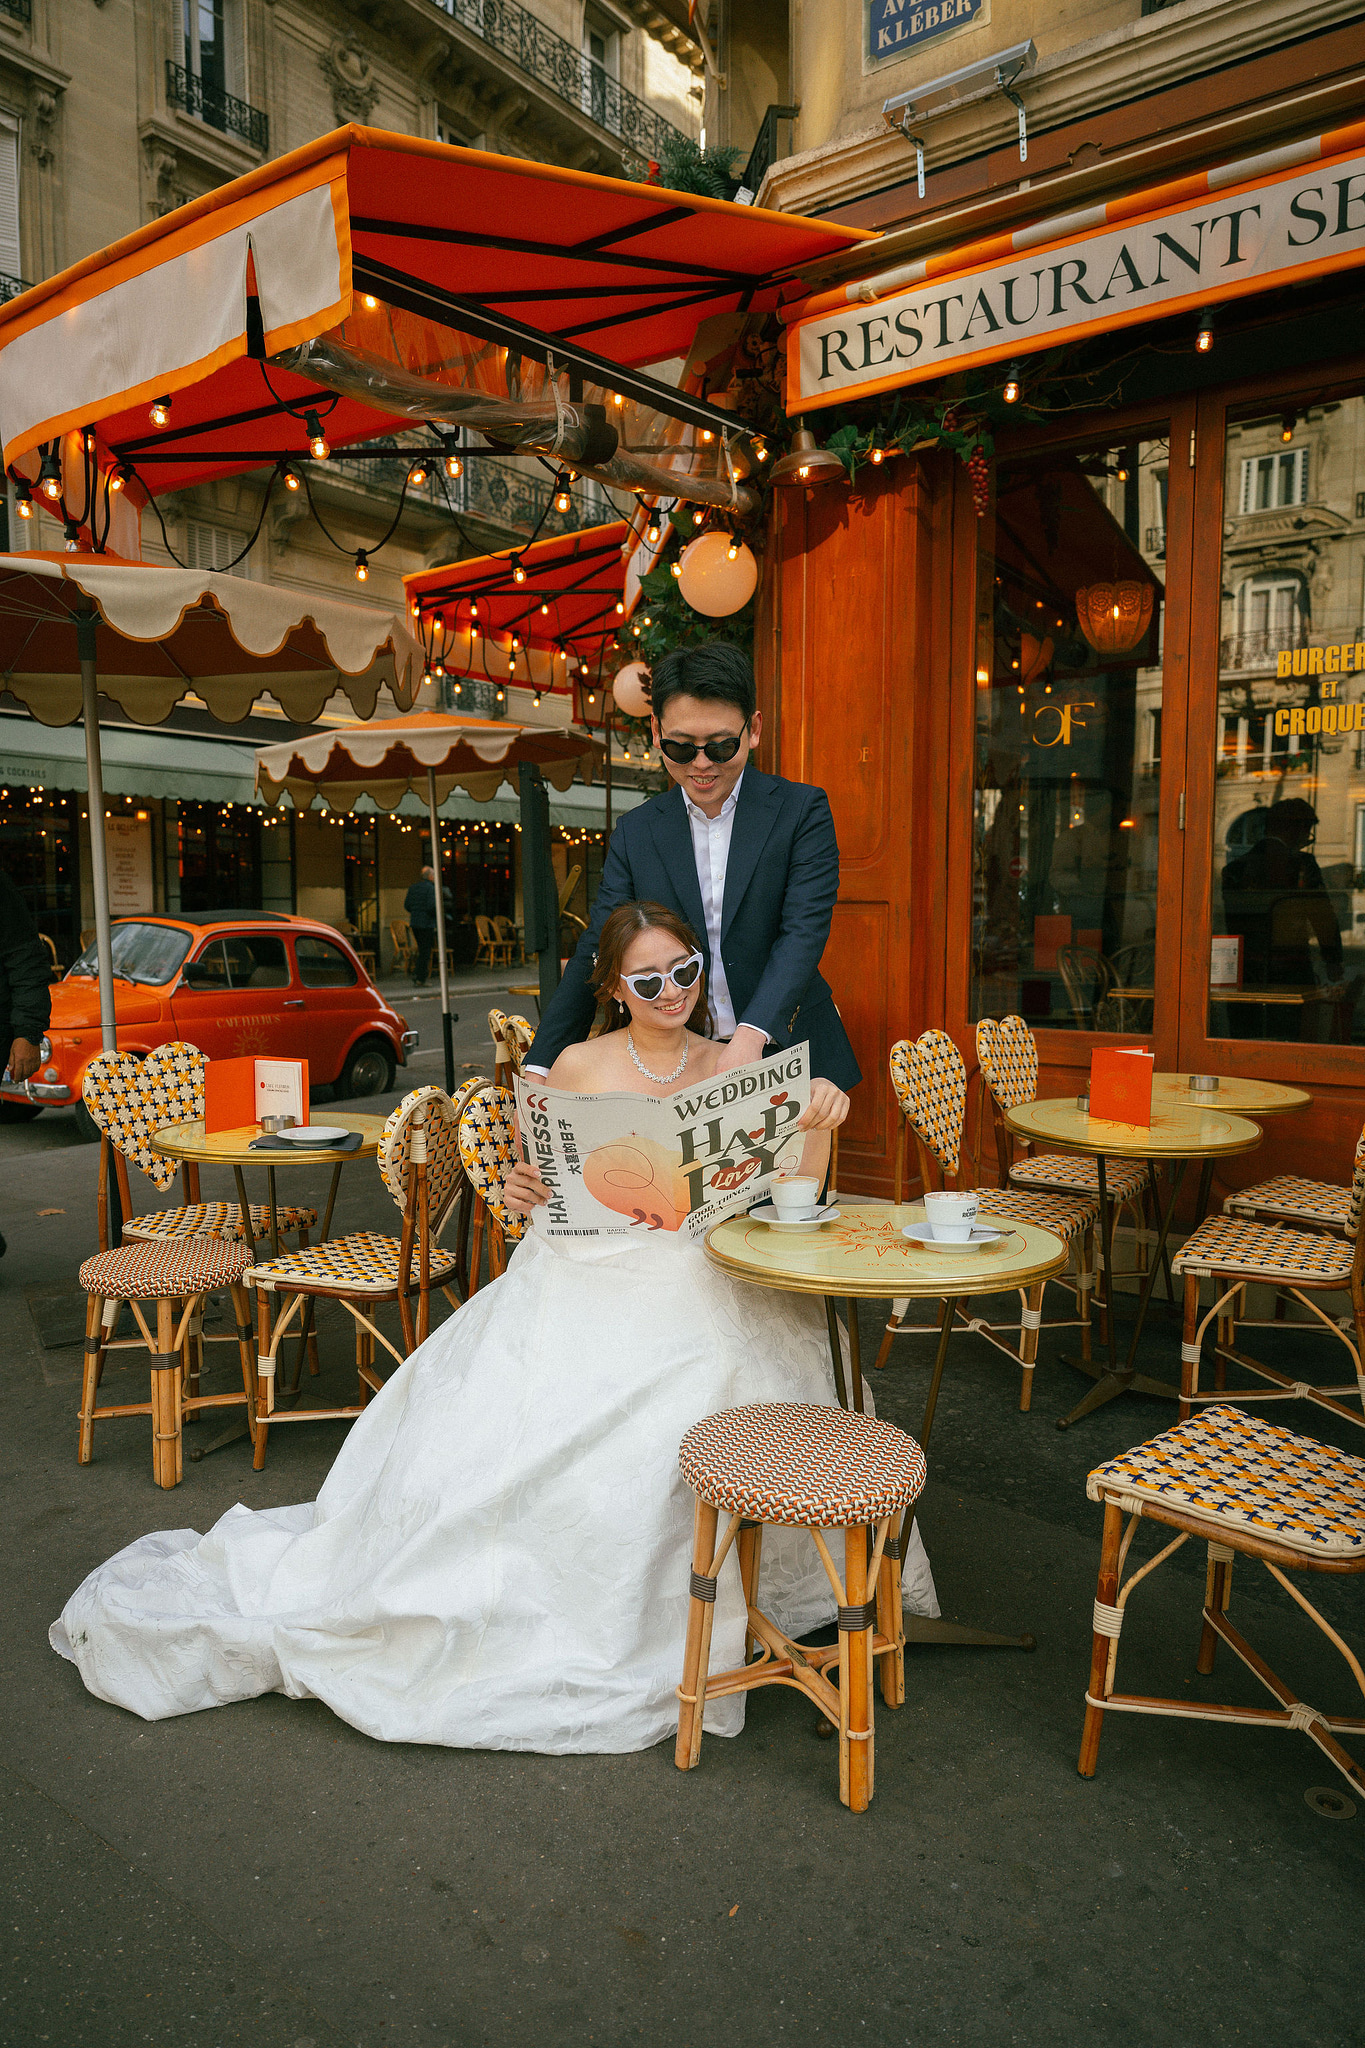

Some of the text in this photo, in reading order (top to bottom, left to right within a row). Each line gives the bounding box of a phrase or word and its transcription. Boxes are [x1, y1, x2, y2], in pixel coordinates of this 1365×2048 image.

[877, 0, 972, 50] KLÉBER
[817, 204, 1262, 381] RESTAURANT
[1277, 642, 1365, 678] BURGER
[1321, 681, 1338, 698] ET
[1275, 703, 1365, 736] CROQUE
[673, 1057, 803, 1121] WEDDING
[714, 1160, 761, 1190] Love
[688, 1185, 751, 1224] GOOD THINGS
